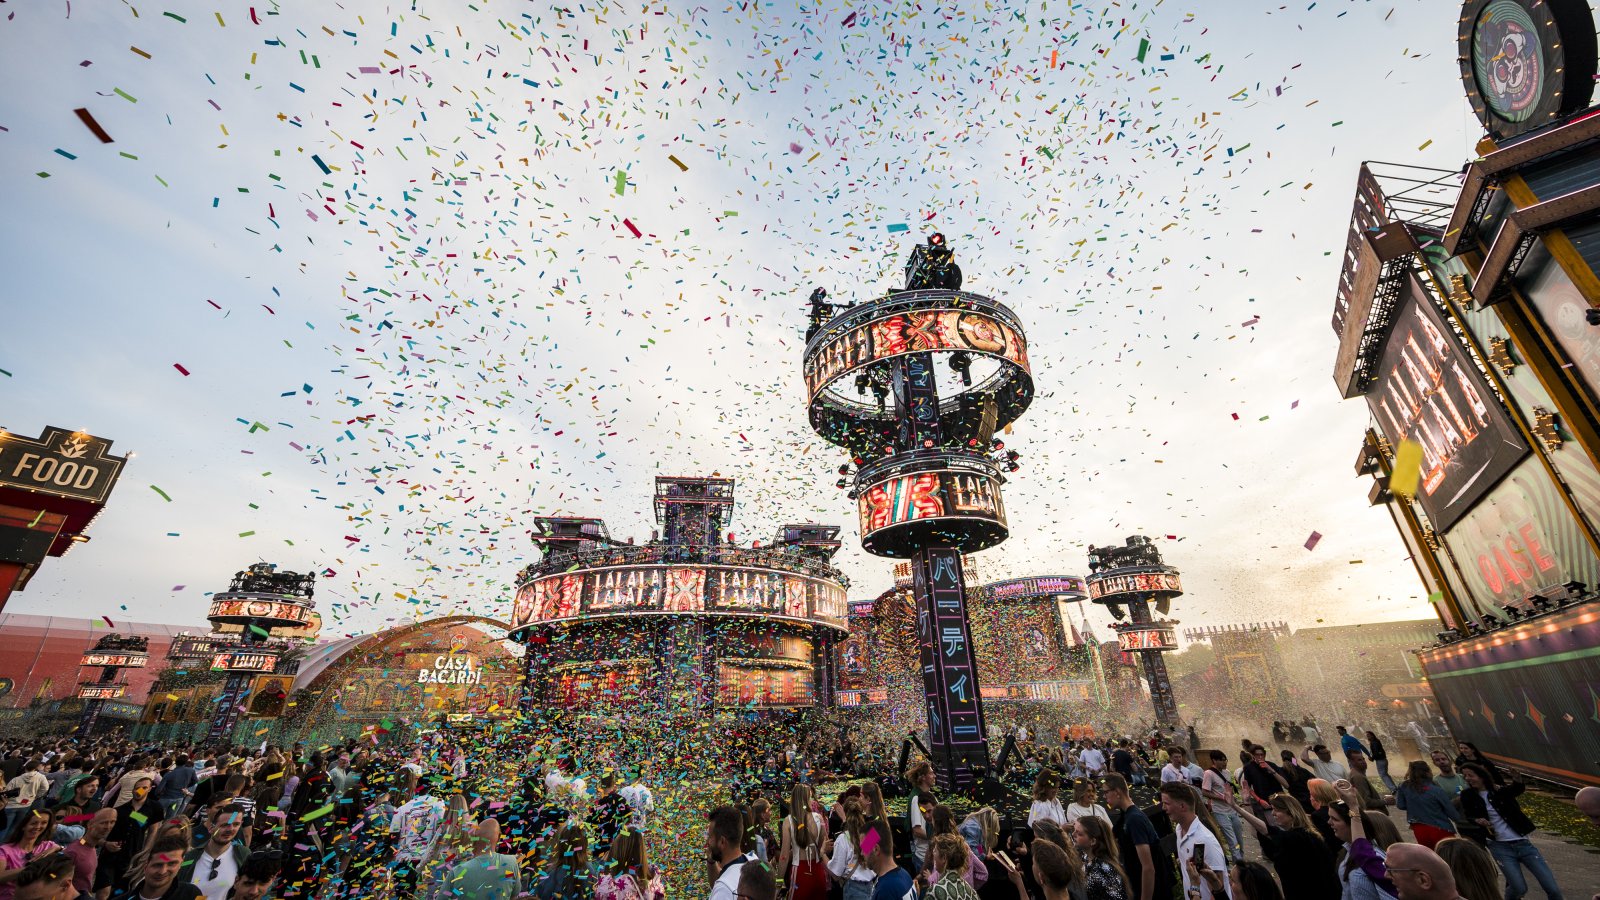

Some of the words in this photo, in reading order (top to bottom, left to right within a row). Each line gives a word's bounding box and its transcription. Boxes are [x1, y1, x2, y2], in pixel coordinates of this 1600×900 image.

[12, 453, 99, 490] FOOD
[1477, 523, 1556, 594] OASE
[191, 643, 210, 651] THE
[434, 656, 472, 670] CASA
[418, 668, 483, 684] BACARDÍ
